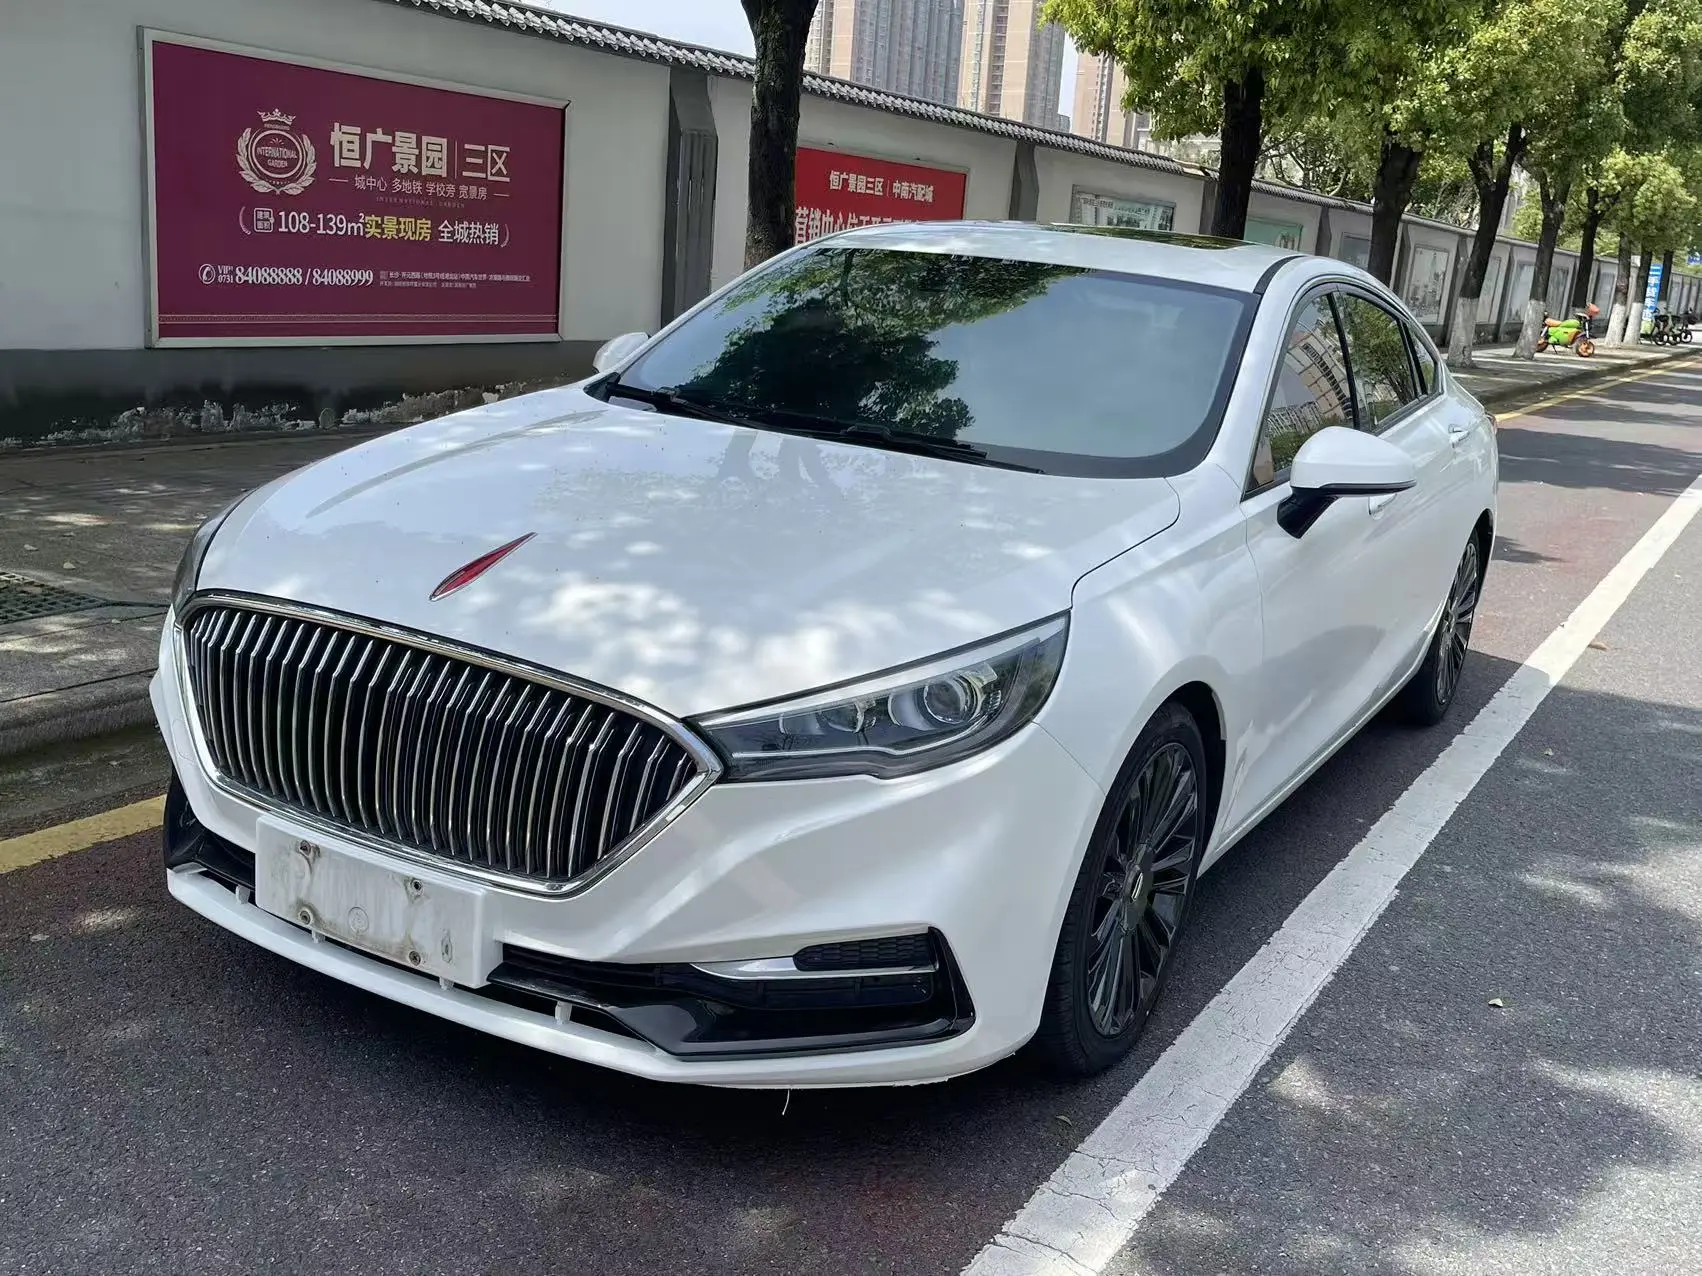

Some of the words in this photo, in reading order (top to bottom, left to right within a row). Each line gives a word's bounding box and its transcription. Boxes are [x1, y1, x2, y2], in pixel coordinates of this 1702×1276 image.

[256, 147, 297, 159] INTERNATIONAL
[267, 160, 288, 168] GARDEN
[330, 122, 448, 178] 恒广景园
[462, 143, 511, 182] 三区
[354, 175, 388, 192] 城中心
[391, 178, 423, 195] 多地铁
[426, 182, 455, 199] 学校旁
[829, 170, 884, 196] 恒广景园三区
[892, 179, 934, 203] 中南汽配城
[438, 220, 499, 246] 全城热销
[235, 266, 303, 285] 84088888
[312, 268, 374, 287] 84088999
